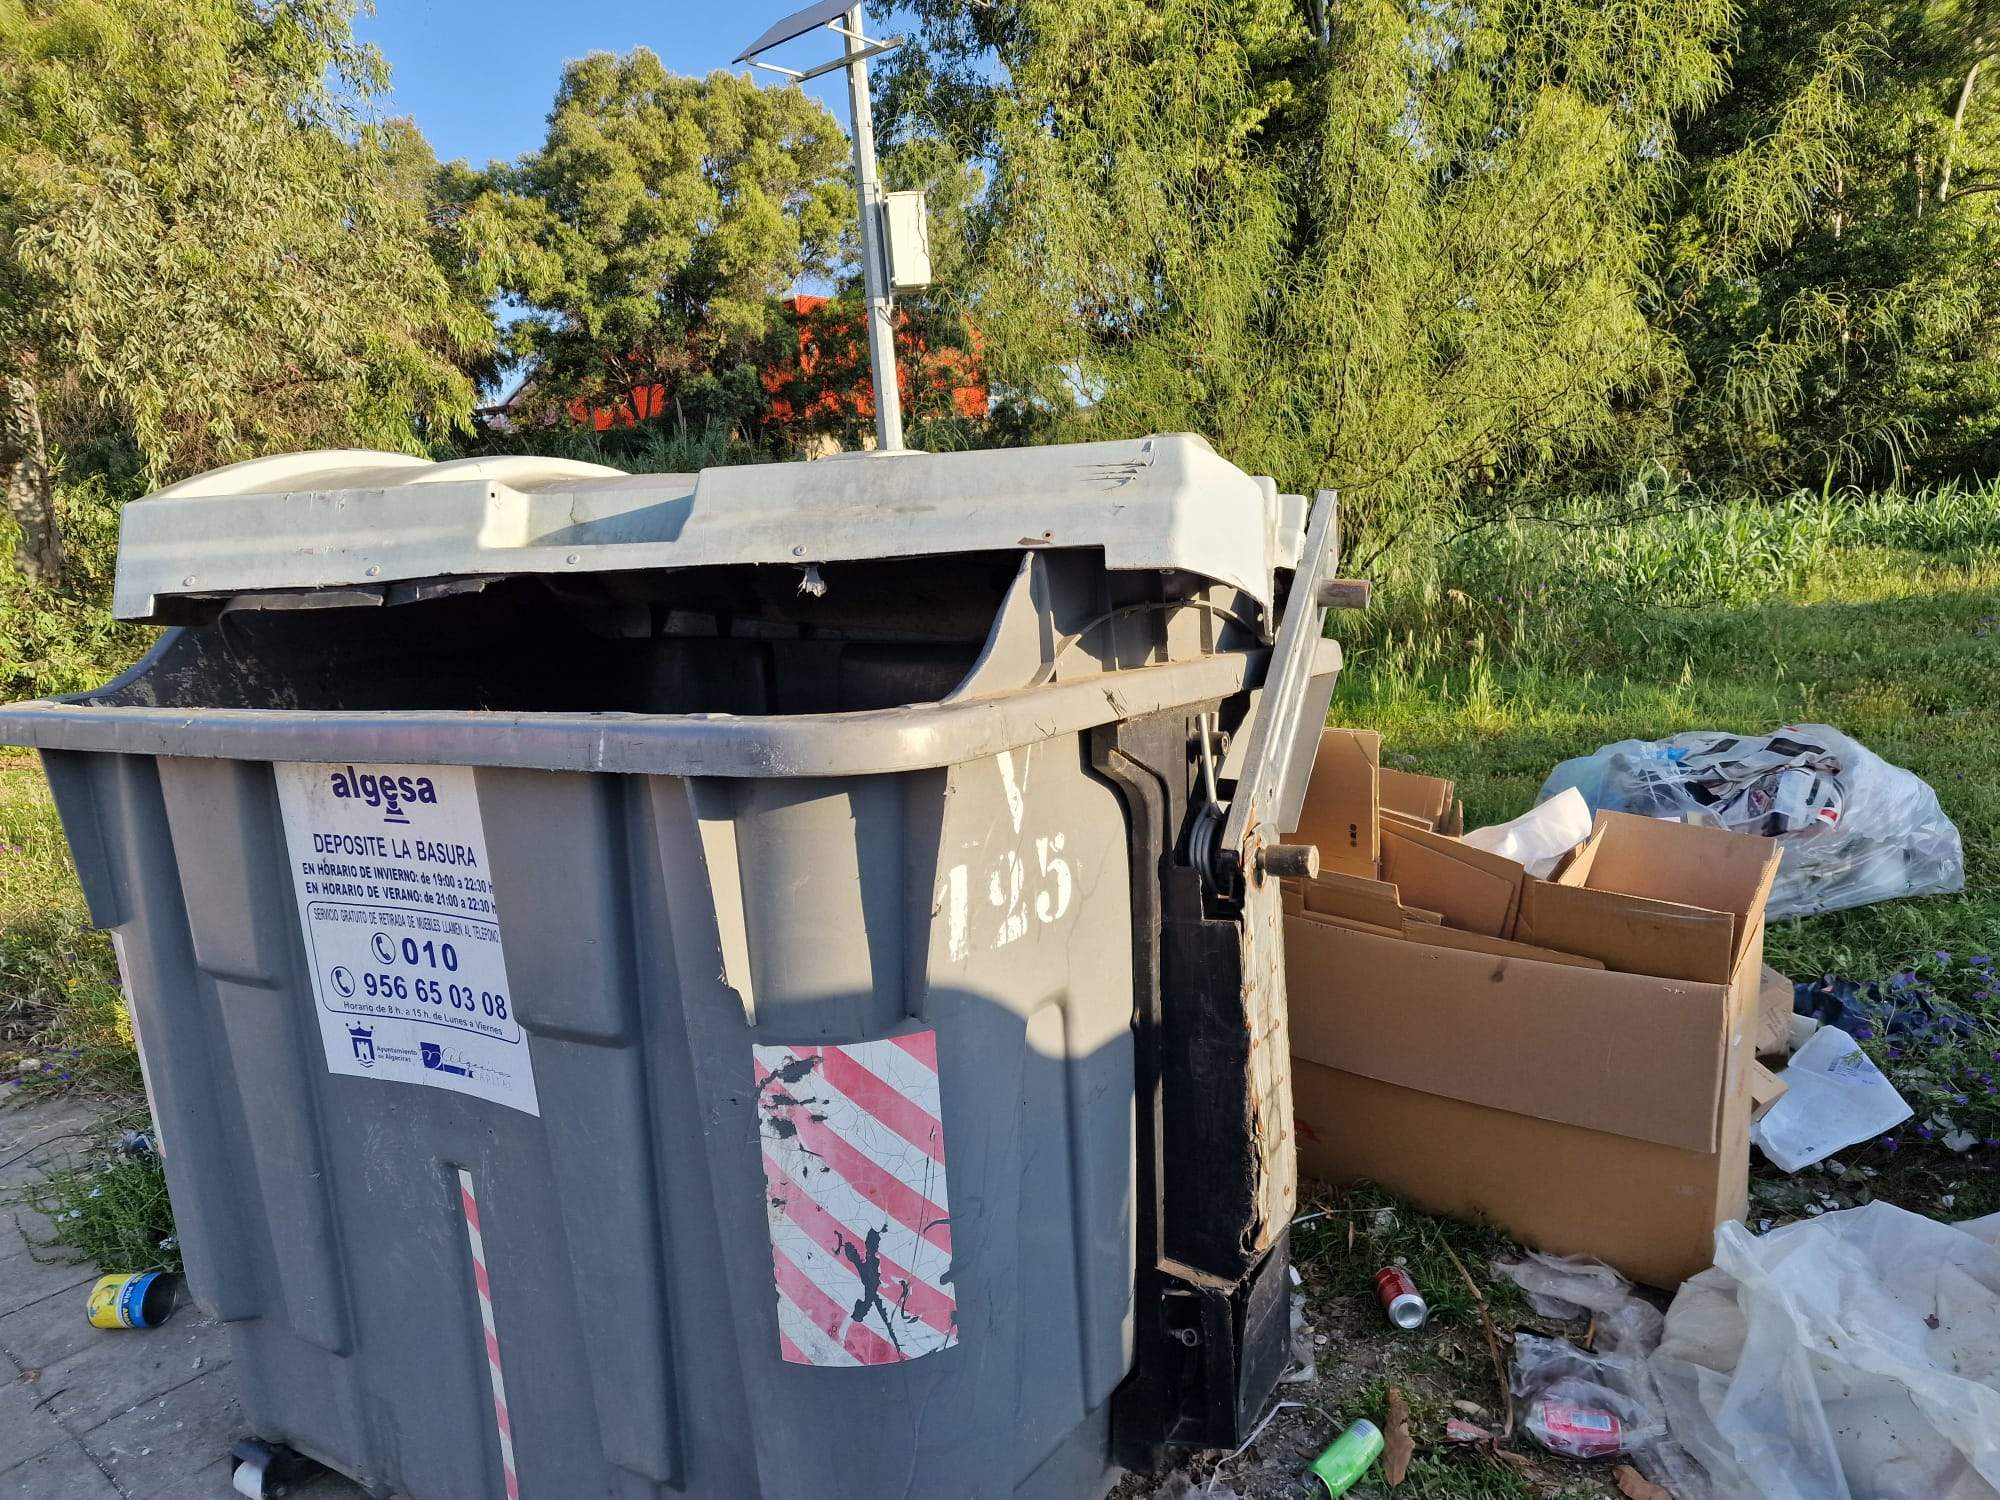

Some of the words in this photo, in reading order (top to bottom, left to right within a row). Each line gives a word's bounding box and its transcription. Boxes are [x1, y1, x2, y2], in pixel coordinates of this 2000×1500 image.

[330, 766, 437, 807] algesa
[313, 833, 387, 857] DEPOSITE
[391, 838, 411, 859] LA
[416, 841, 477, 867] BASURA
[302, 863, 315, 874] EN
[317, 863, 357, 877] HORARIO
[359, 866, 372, 878] DE
[374, 867, 419, 882] INVIERNO:
[421, 872, 430, 884] de
[433, 873, 455, 888] 19:00
[457, 879, 462, 889] a
[464, 877, 486, 893] 22:30
[305, 882, 319, 894] EN
[322, 883, 363, 897] HORARIO
[367, 886, 379, 898] DE
[382, 886, 422, 902] VERANO:
[424, 891, 434, 903] de
[436, 892, 458, 907] 21:00
[461, 899, 465, 908] a
[467, 897, 489, 912] 22:30
[313, 908, 338, 921] SERVICIO
[341, 909, 367, 924] GRATUITO
[369, 911, 377, 924] DE
[379, 912, 406, 927] RETIRADA
[407, 915, 415, 928] DE
[416, 916, 440, 932] MUEBLES
[442, 921, 462, 935] LLAMEN
[465, 924, 471, 938] AL
[402, 937, 458, 971] 010
[363, 972, 408, 1000] 956
[415, 978, 442, 1005] 65
[449, 984, 475, 1011] 03
[482, 991, 508, 1020] 08
[343, 1001, 374, 1012] Horario
[376, 1004, 386, 1013] de
[388, 1005, 393, 1014] 8
[413, 1008, 422, 1017] 15
[423, 1010, 431, 1019] h.
[433, 1012, 442, 1021] de
[444, 1013, 468, 1027] Lunes
[475, 1021, 502, 1036] Viernes
[376, 1045, 418, 1056] Ayuntamiento
[385, 1053, 412, 1063] Algeciras
